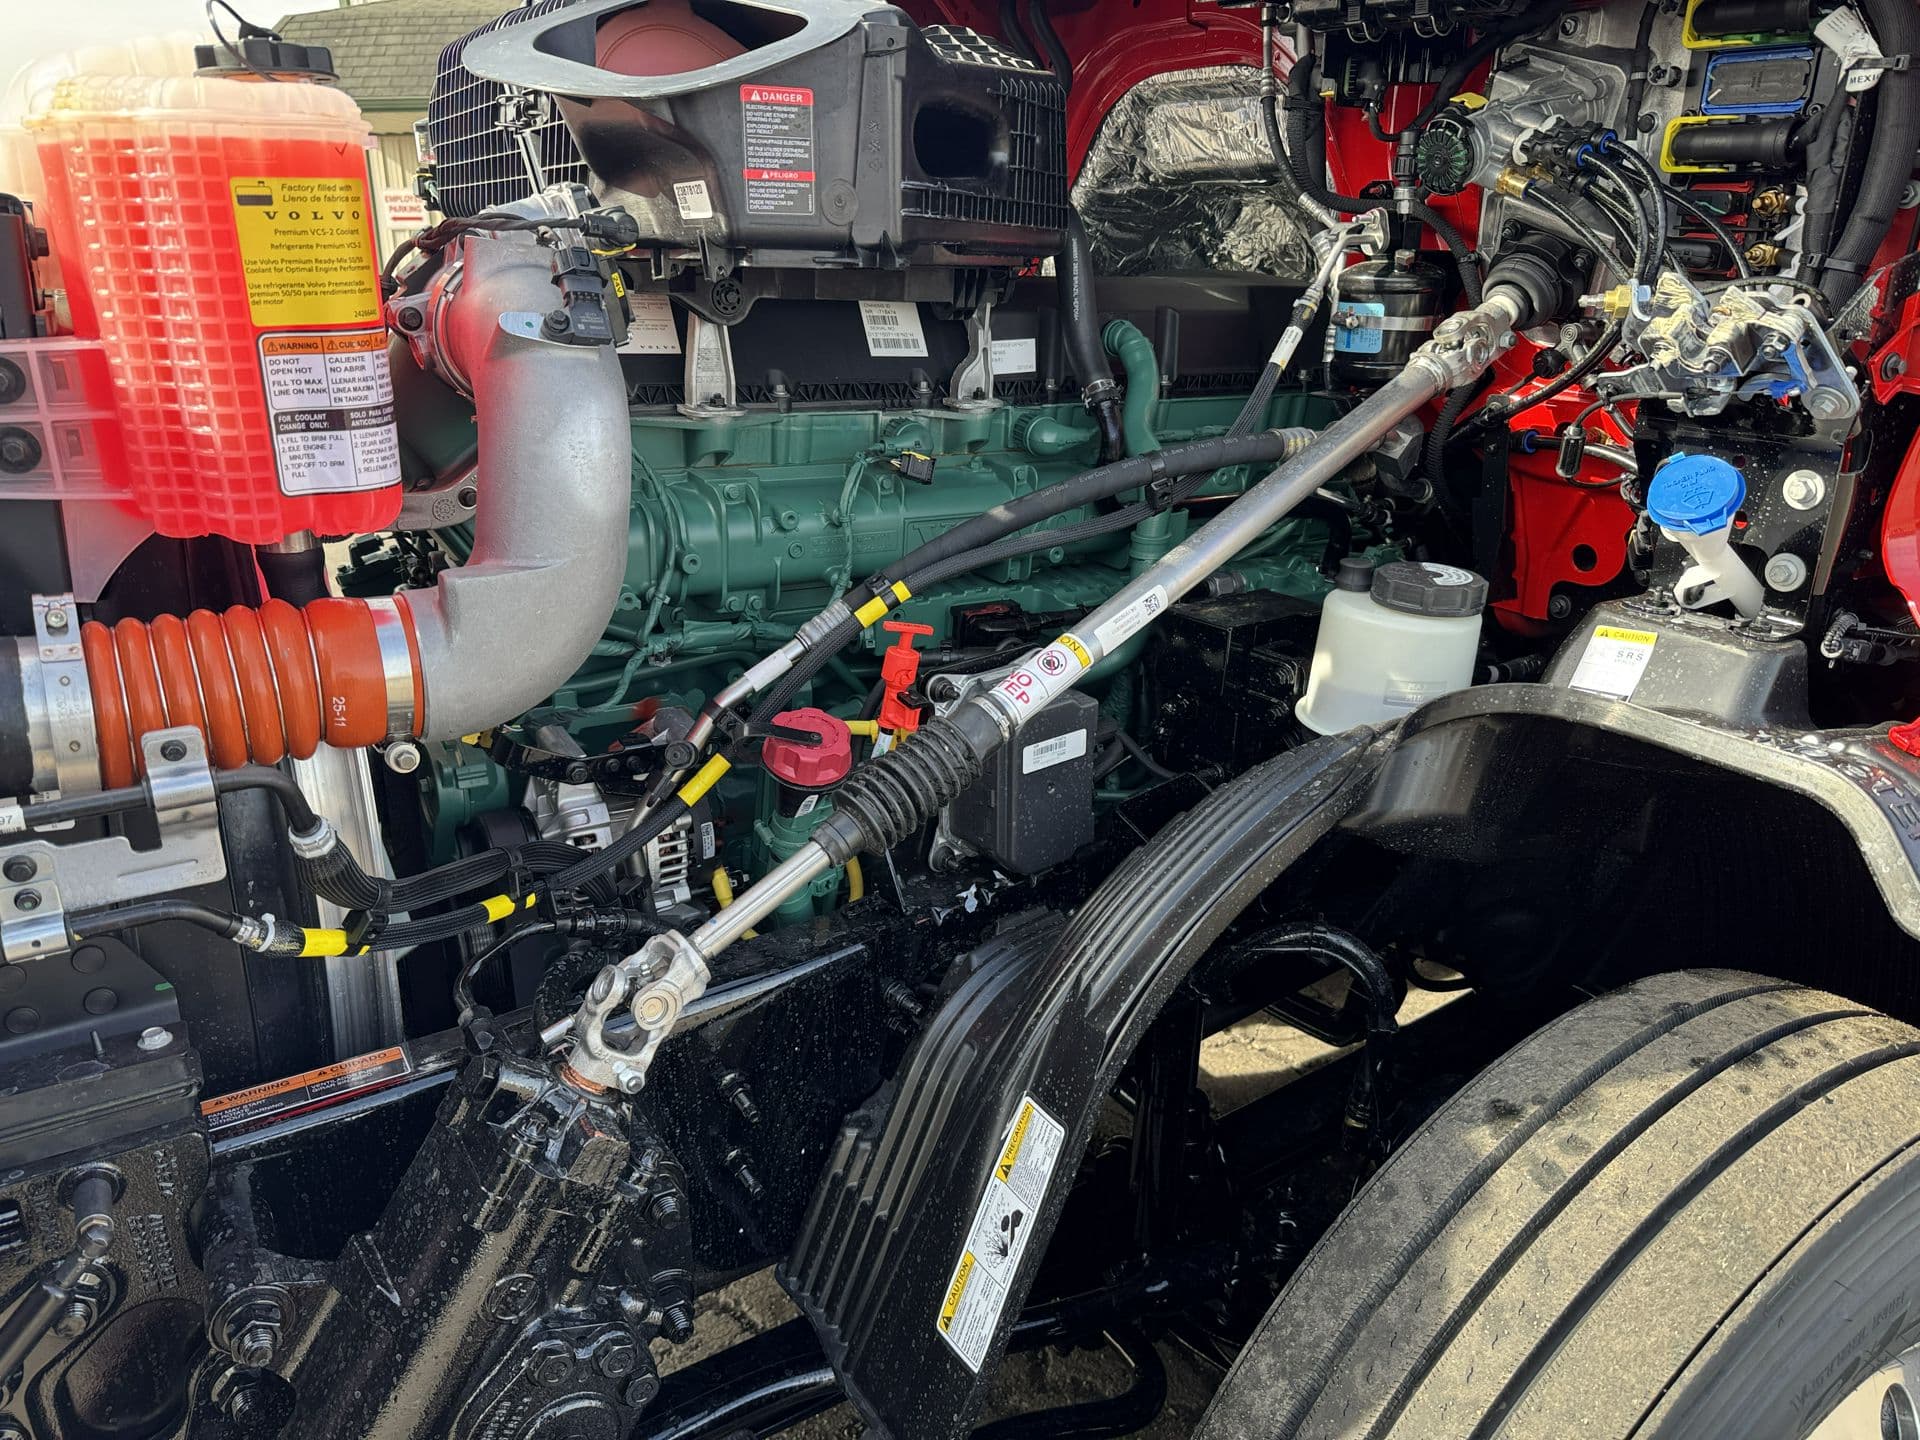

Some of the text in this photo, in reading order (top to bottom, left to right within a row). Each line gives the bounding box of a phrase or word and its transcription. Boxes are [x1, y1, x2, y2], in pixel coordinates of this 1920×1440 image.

[762, 92, 803, 102] DANGER
[281, 184, 315, 193] Factory
[263, 210, 360, 220] VOLVO
[612, 275, 622, 294] 24V
[350, 411, 366, 419] SOLO
[1078, 468, 1111, 483] EverCool
[1614, 632, 1649, 642] CAUTION
[1617, 650, 1644, 661] SRS
[332, 696, 347, 726] 25-11
[330, 1053, 387, 1072] CUIDADO
[227, 1080, 290, 1101] WARNING
[242, 1099, 266, 1109] START
[209, 1102, 284, 1127] WITHOUT WARNING
[221, 1108, 250, 1119] ROTATE
[1006, 1106, 1030, 1159] PRECAUTION
[987, 1184, 998, 1203] SYSTEM
[949, 1261, 969, 1306] CAUTION
